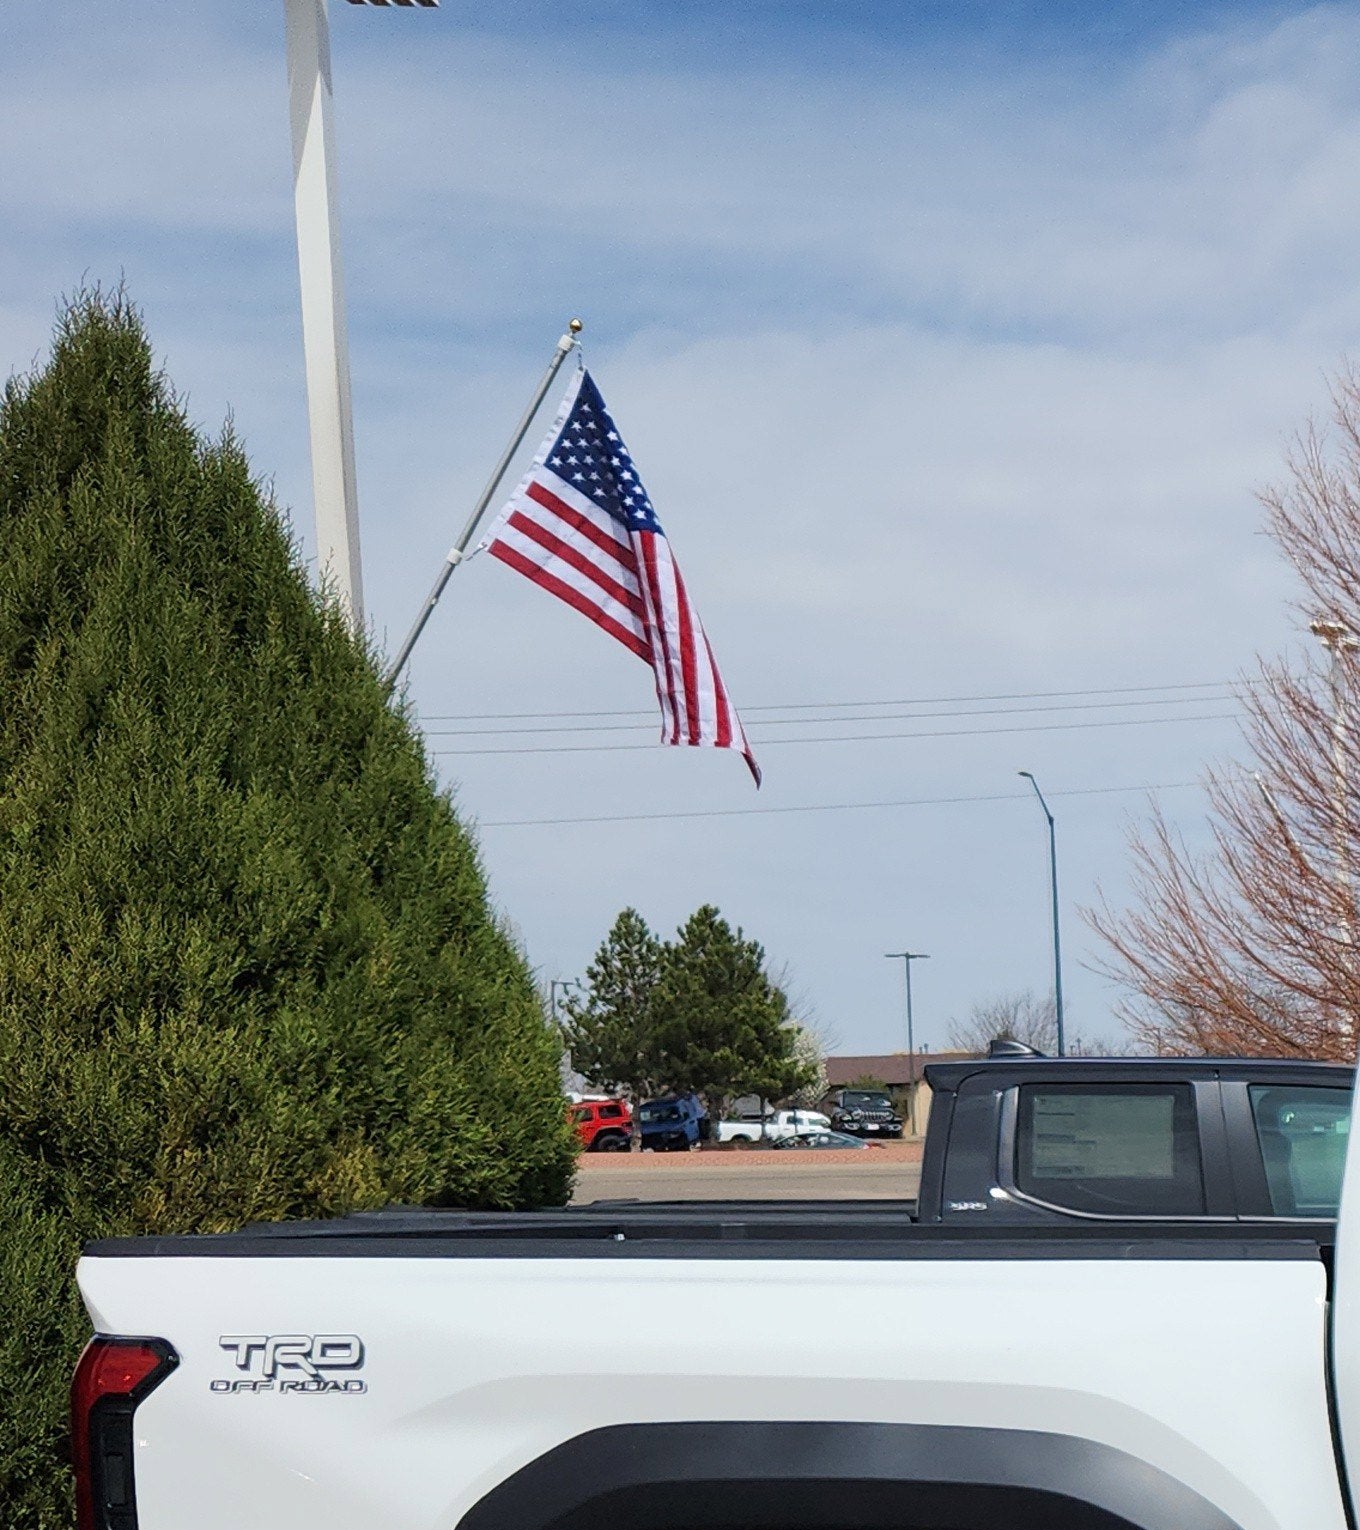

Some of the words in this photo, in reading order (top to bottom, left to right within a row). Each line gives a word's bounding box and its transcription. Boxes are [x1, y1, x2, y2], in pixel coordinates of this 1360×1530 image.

[219, 1334, 365, 1379] TRD
[210, 1379, 274, 1394] OFF
[279, 1379, 368, 1394] ROAD
